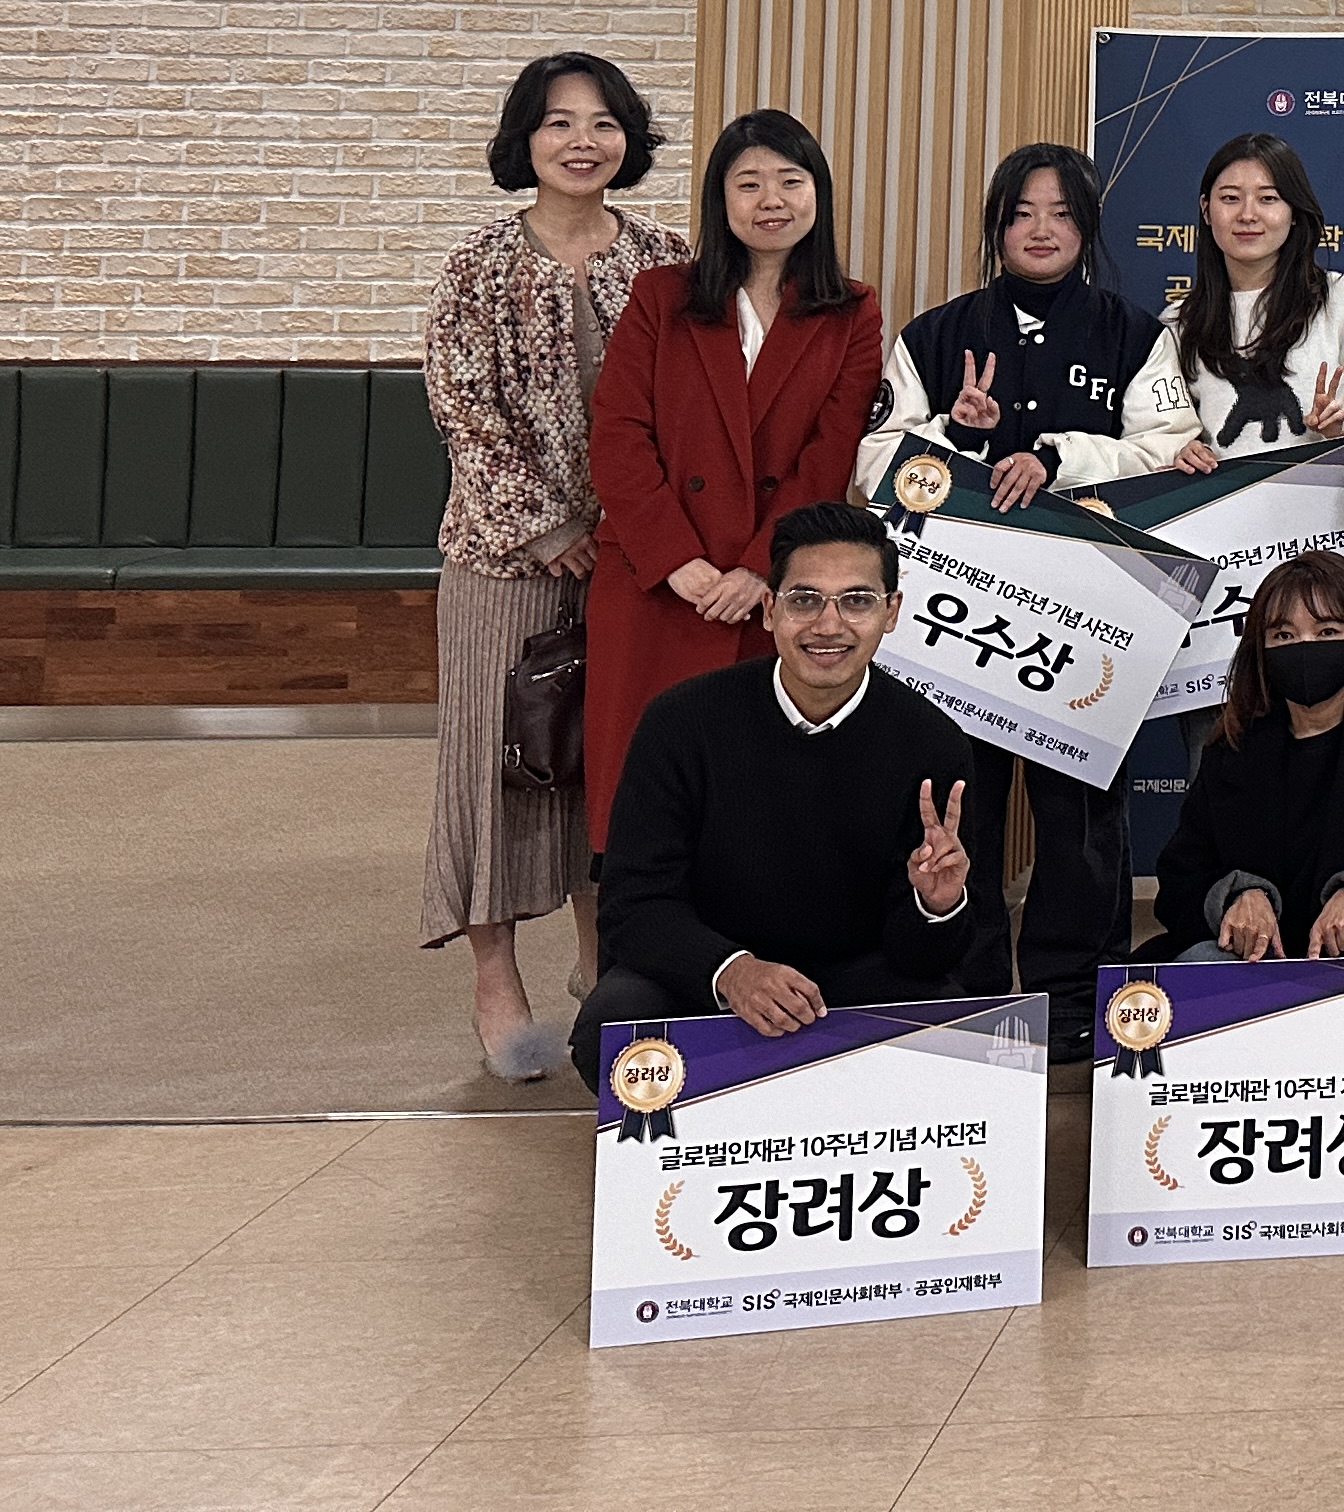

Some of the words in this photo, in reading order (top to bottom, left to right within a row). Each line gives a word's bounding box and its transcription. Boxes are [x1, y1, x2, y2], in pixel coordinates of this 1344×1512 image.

[1152, 376, 1190, 412] 11
[906, 471, 940, 495] 우수상
[1210, 546, 1263, 570] 0주년
[1266, 539, 1298, 560] 기념
[898, 538, 997, 592] 글로벌인재관
[995, 578, 1050, 615] 10주년
[1046, 600, 1084, 628] 기념
[1083, 617, 1135, 652] 사진전
[913, 592, 1075, 693] 우수상
[1133, 779, 1190, 793] 국제인문
[1118, 1008, 1160, 1023] 장려상
[624, 1066, 671, 1083] 장려상
[1148, 1079, 1270, 1106] 글로벌인재관
[1274, 1076, 1336, 1100] 10주년
[659, 1137, 795, 1171] 글로벌인재관
[800, 1129, 868, 1159] 10주년
[875, 1126, 917, 1151] 기념
[920, 1120, 988, 1147] 사진전
[713, 1167, 931, 1252] 장려상
[1153, 1226, 1214, 1238] 전북대학교
[665, 1294, 733, 1314] 전북대학교
